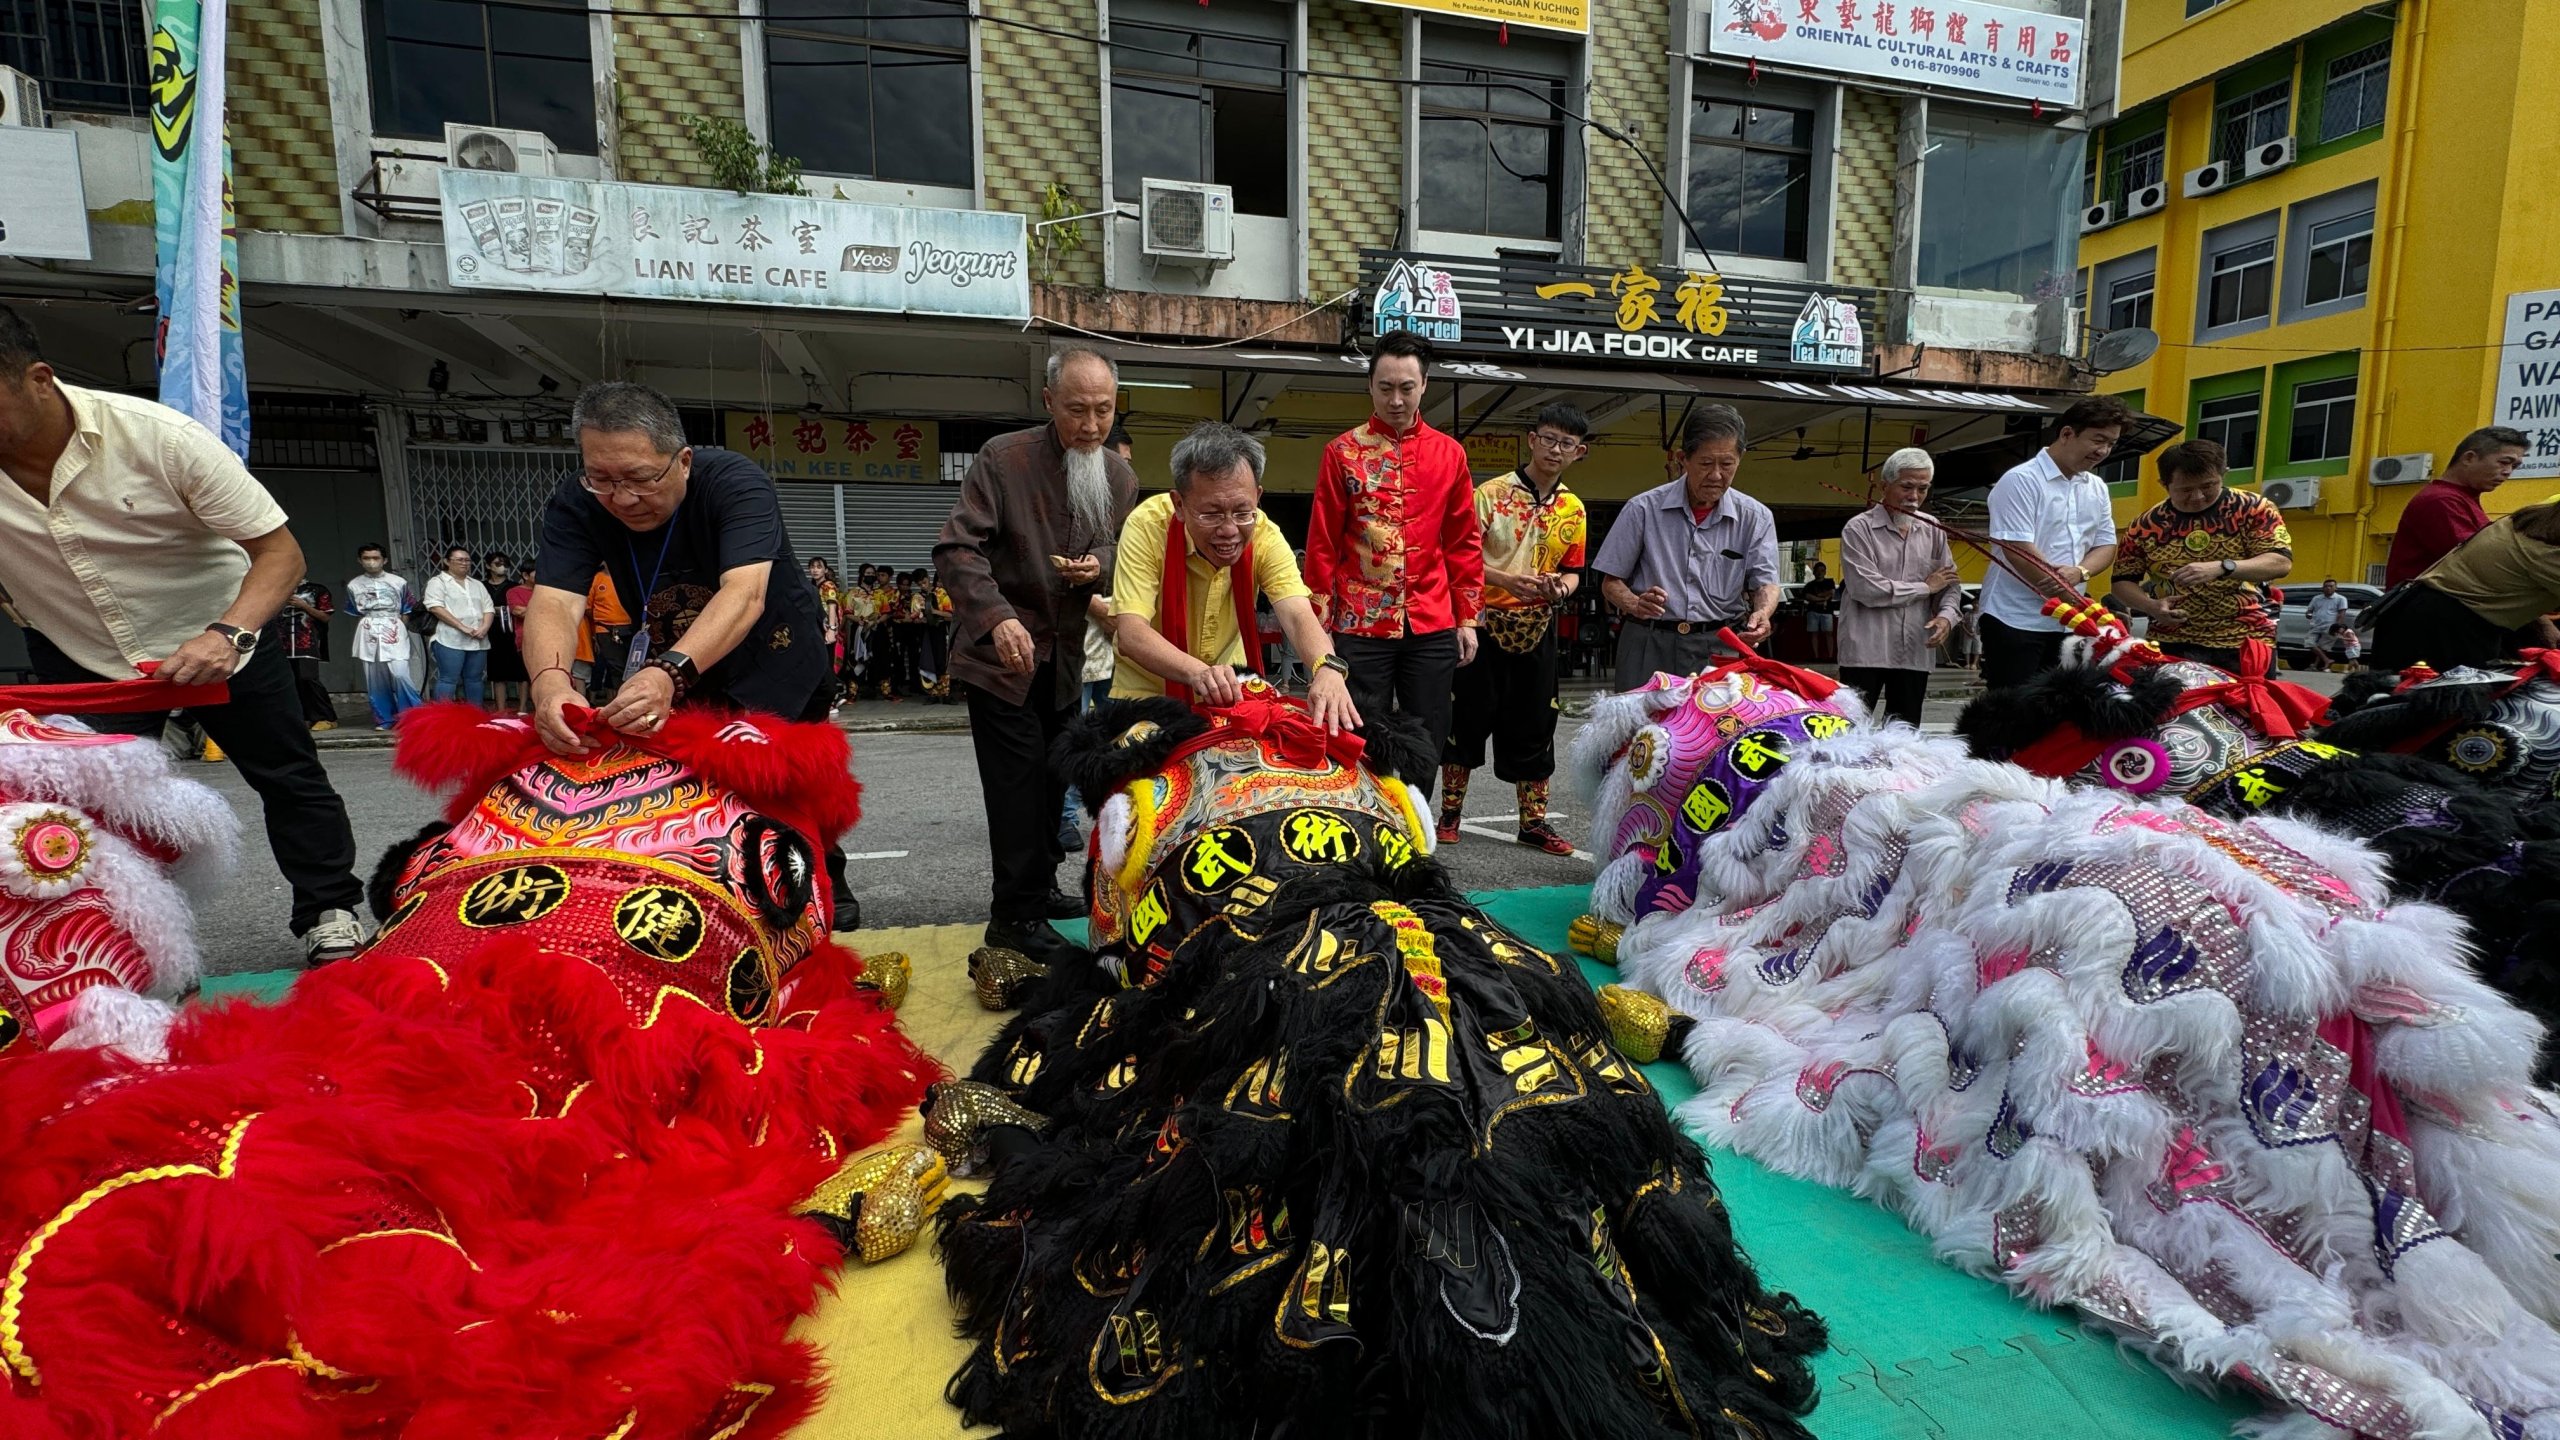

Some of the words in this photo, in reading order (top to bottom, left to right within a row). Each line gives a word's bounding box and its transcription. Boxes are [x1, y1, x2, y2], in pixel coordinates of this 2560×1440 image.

[1534, 1, 1580, 15] KUCHING
[1796, 26, 1872, 48] ORIENTAL
[1877, 38, 1955, 60] CULTURAL
[1960, 51, 1997, 67] ARTS
[2001, 57, 2011, 69] &
[2016, 60, 2069, 78] CRAFTS
[1797, 0, 2071, 63] 東藝龍獅體育用品
[1902, 58, 1980, 79] 016-8709906
[632, 206, 822, 255] 良記茶室
[635, 258, 694, 281] LIAN
[708, 263, 754, 284] KEE
[765, 268, 828, 289] CAFE
[852, 249, 893, 268] Yeo's
[905, 241, 1017, 287] Yeogurt
[1536, 265, 1728, 336] 一家福
[1376, 313, 1402, 336] Tea
[1406, 316, 1459, 340] Garden
[1501, 326, 1535, 350] YI
[1542, 330, 1596, 354] JIA
[1604, 333, 1694, 360] FOOK
[1701, 346, 1758, 363] CAFE
[1793, 343, 1814, 362] Tea
[1818, 344, 1862, 364] Garden
[743, 415, 924, 461] 良記茶室
[758, 459, 796, 474] IAN
[808, 460, 853, 476] KEE
[864, 463, 924, 480] CAFE
[1191, 831, 1253, 887] 武
[621, 889, 697, 960] 健
